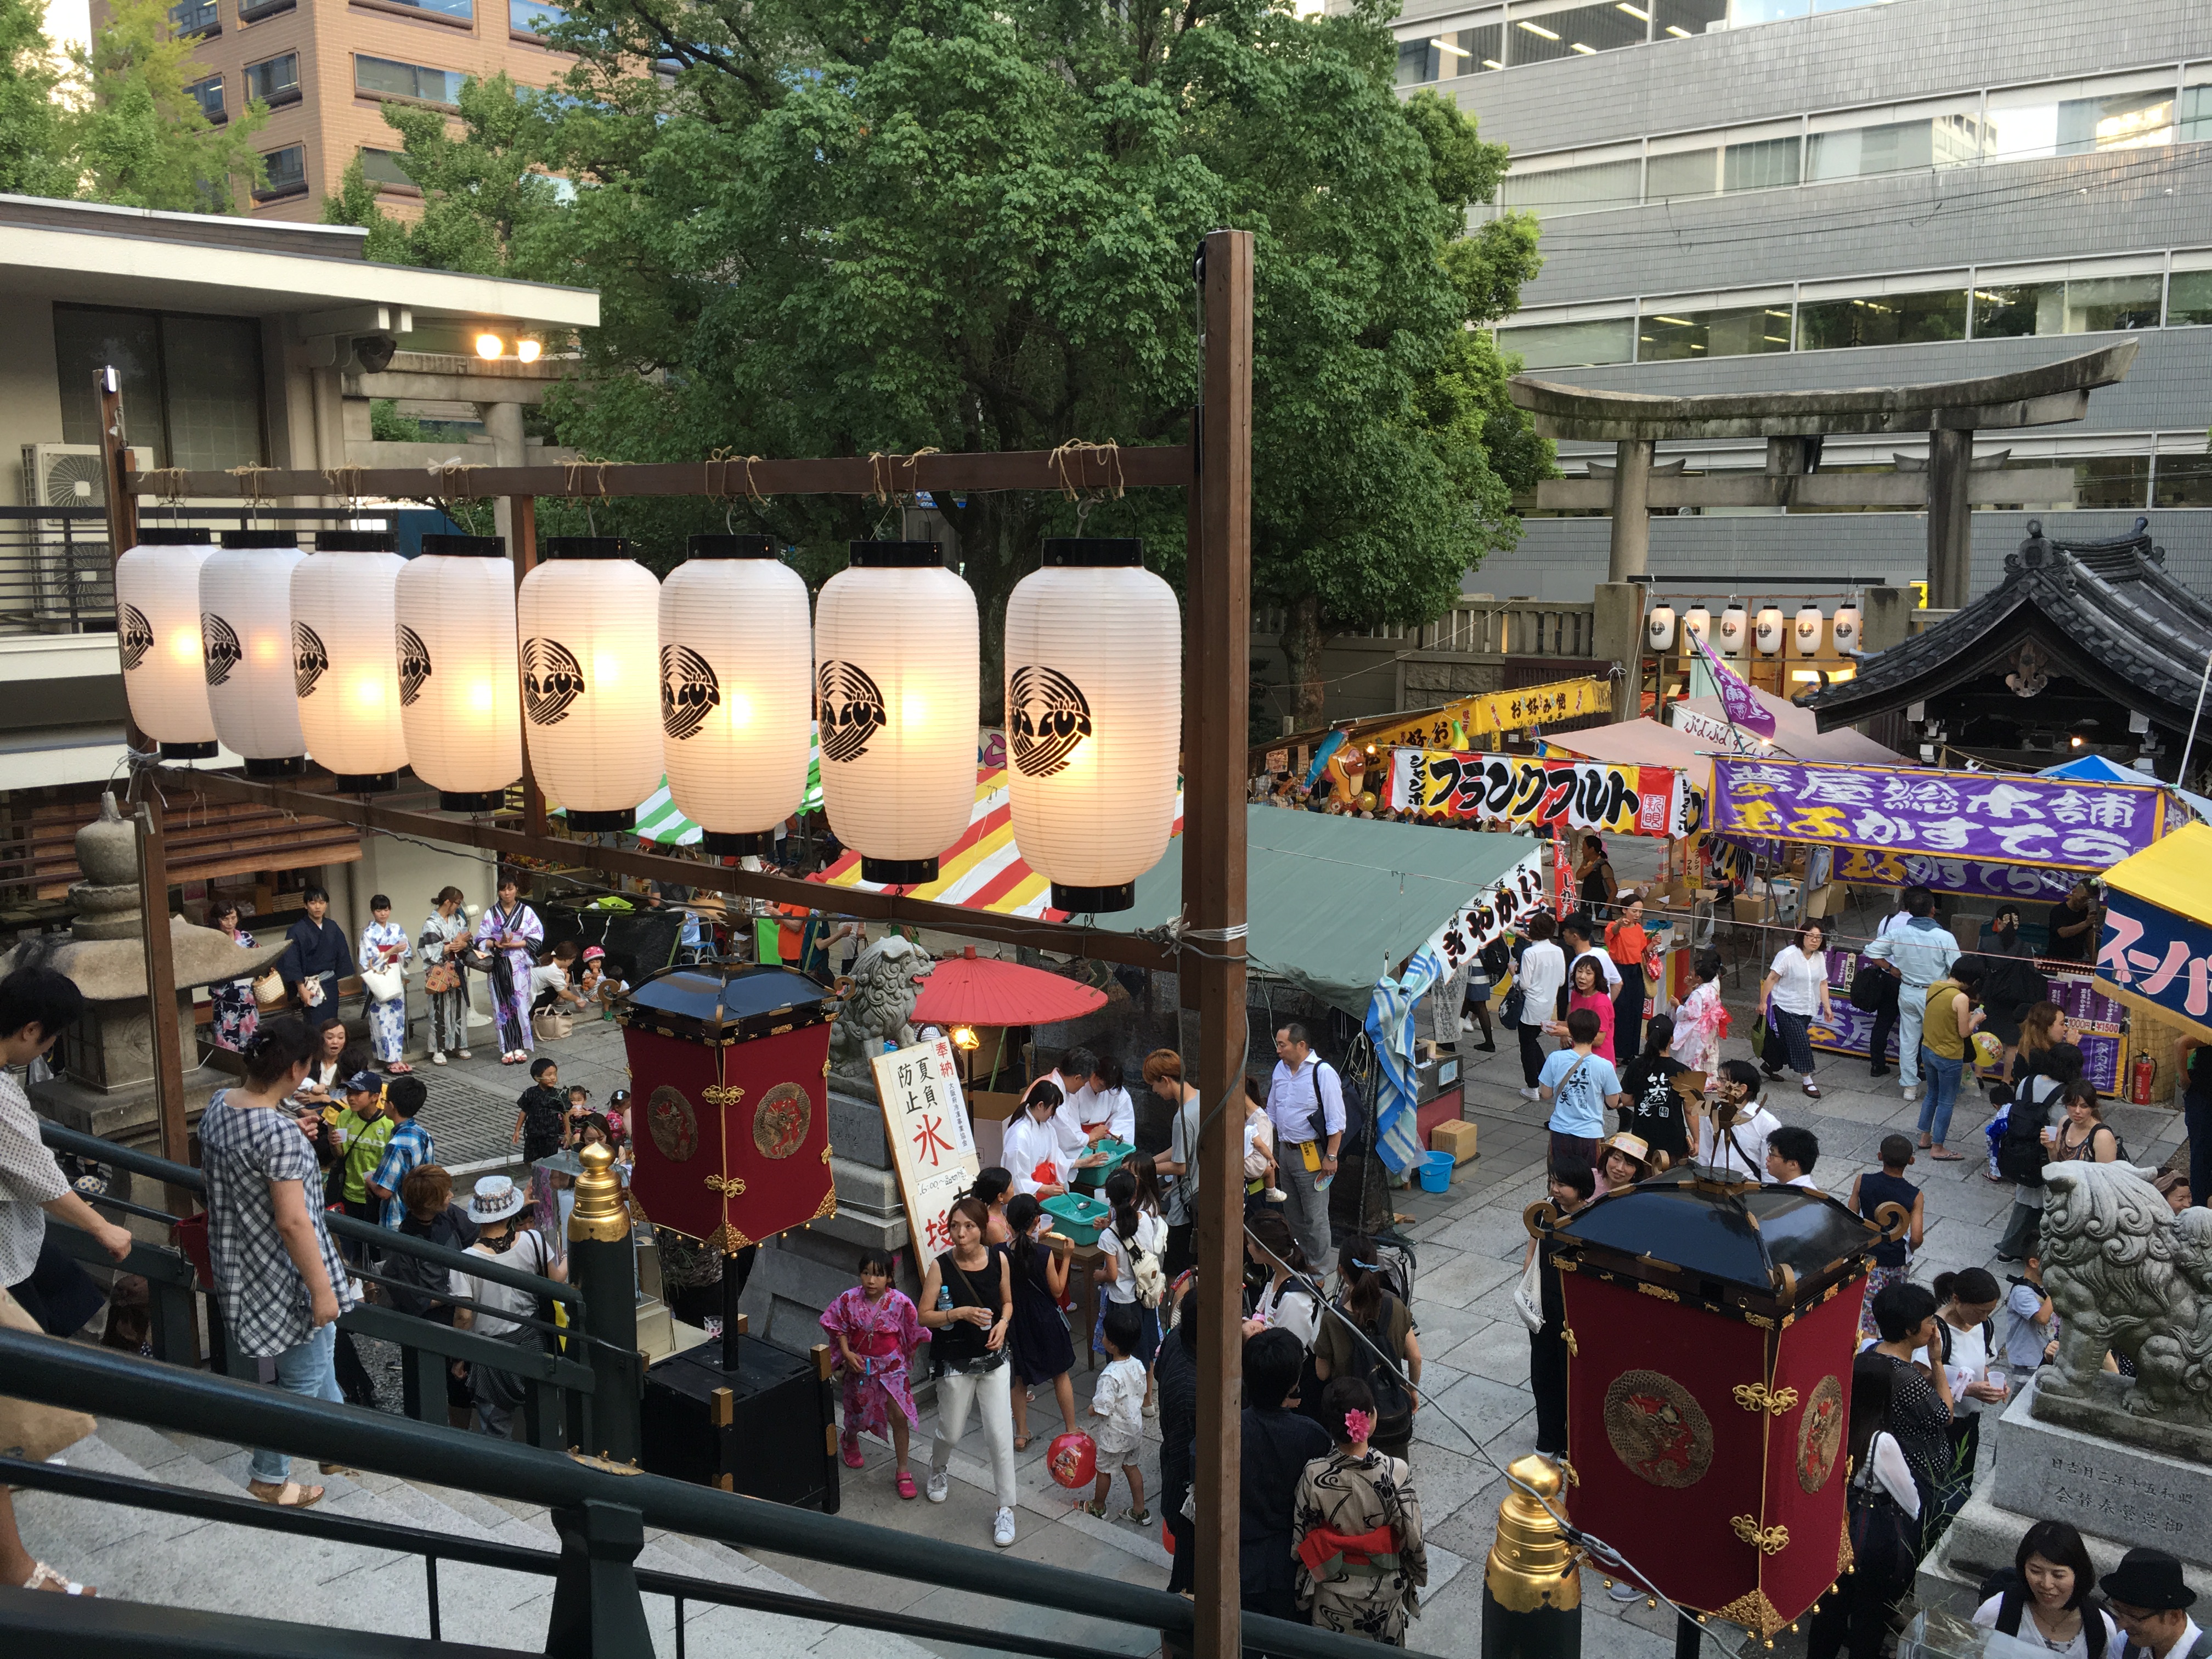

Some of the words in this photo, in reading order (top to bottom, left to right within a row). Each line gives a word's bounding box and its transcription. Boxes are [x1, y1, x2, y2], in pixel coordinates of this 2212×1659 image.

[1408, 755, 1430, 806] ジャンボ
[1429, 759, 1640, 825] フランクフルト
[1728, 765, 2136, 828] 夢屋総本舗
[2068, 1018, 2091, 1029] 1000円
[2096, 1022, 2119, 1033] ¥1500
[935, 1042, 953, 1078] 奉納
[912, 1114, 955, 1167] 氷
